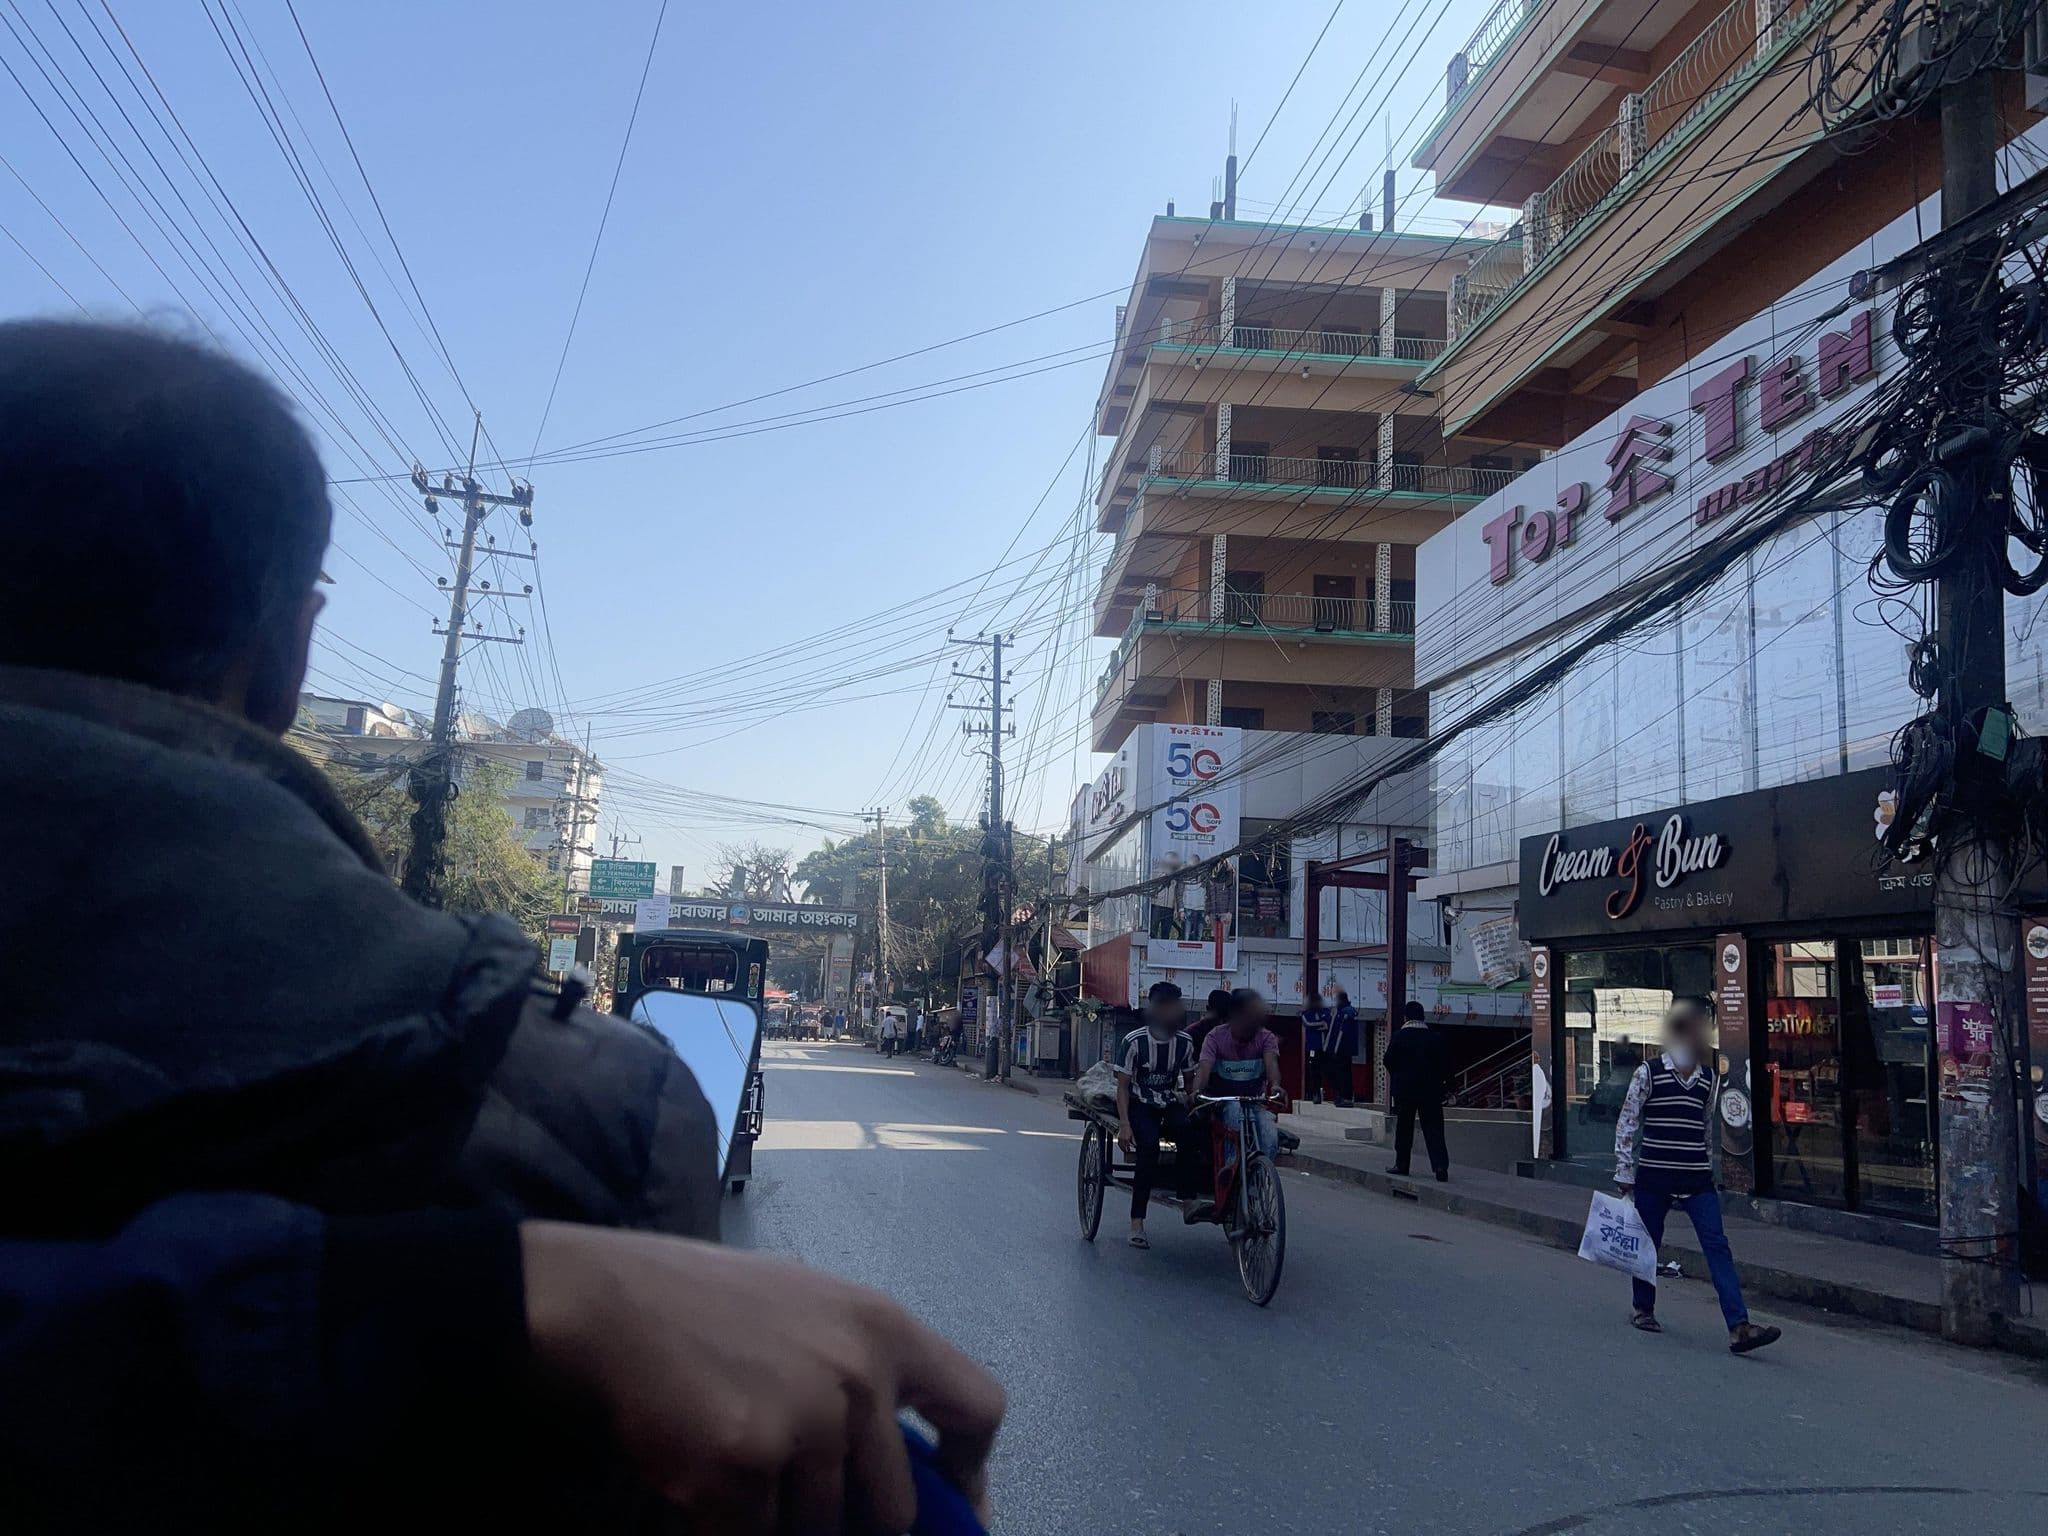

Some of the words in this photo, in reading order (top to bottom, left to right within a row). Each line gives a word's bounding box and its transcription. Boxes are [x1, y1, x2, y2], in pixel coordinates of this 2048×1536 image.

[1482, 481, 1585, 587] TOP
[1691, 310, 1873, 466] TEN
[1539, 834, 1613, 897] Cream
[1656, 814, 1722, 888] Bun
[613, 886, 641, 894] AIRPORT
[1686, 893, 1694, 907] &
[1696, 891, 1734, 907] Bakery
[601, 900, 639, 914] আমা
[753, 909, 799, 925] আমার
[800, 911, 858, 928] অহংকার
